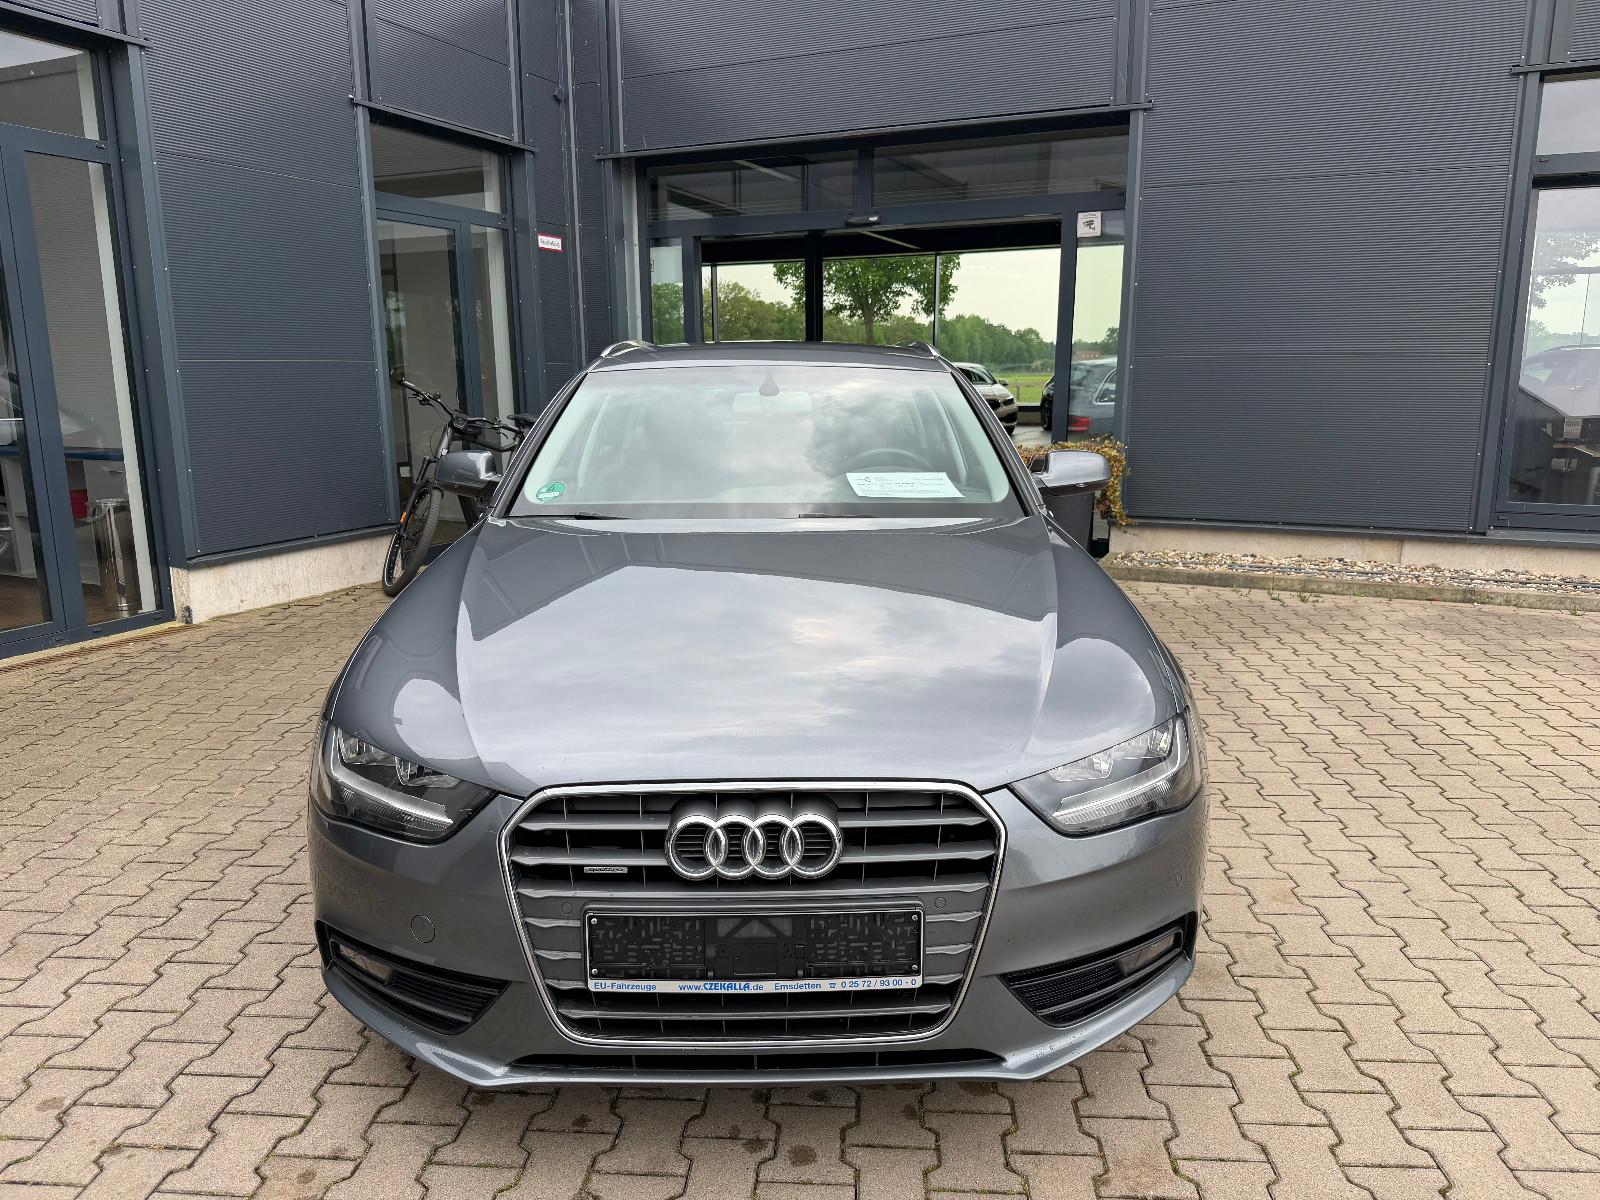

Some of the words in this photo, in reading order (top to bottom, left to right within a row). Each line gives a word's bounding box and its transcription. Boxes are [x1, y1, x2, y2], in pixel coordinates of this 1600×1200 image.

[594, 982, 656, 992] EU-Fahrzeuge
[678, 982, 764, 992] www.CZEKALLA.de
[774, 982, 821, 990] Emsdetten
